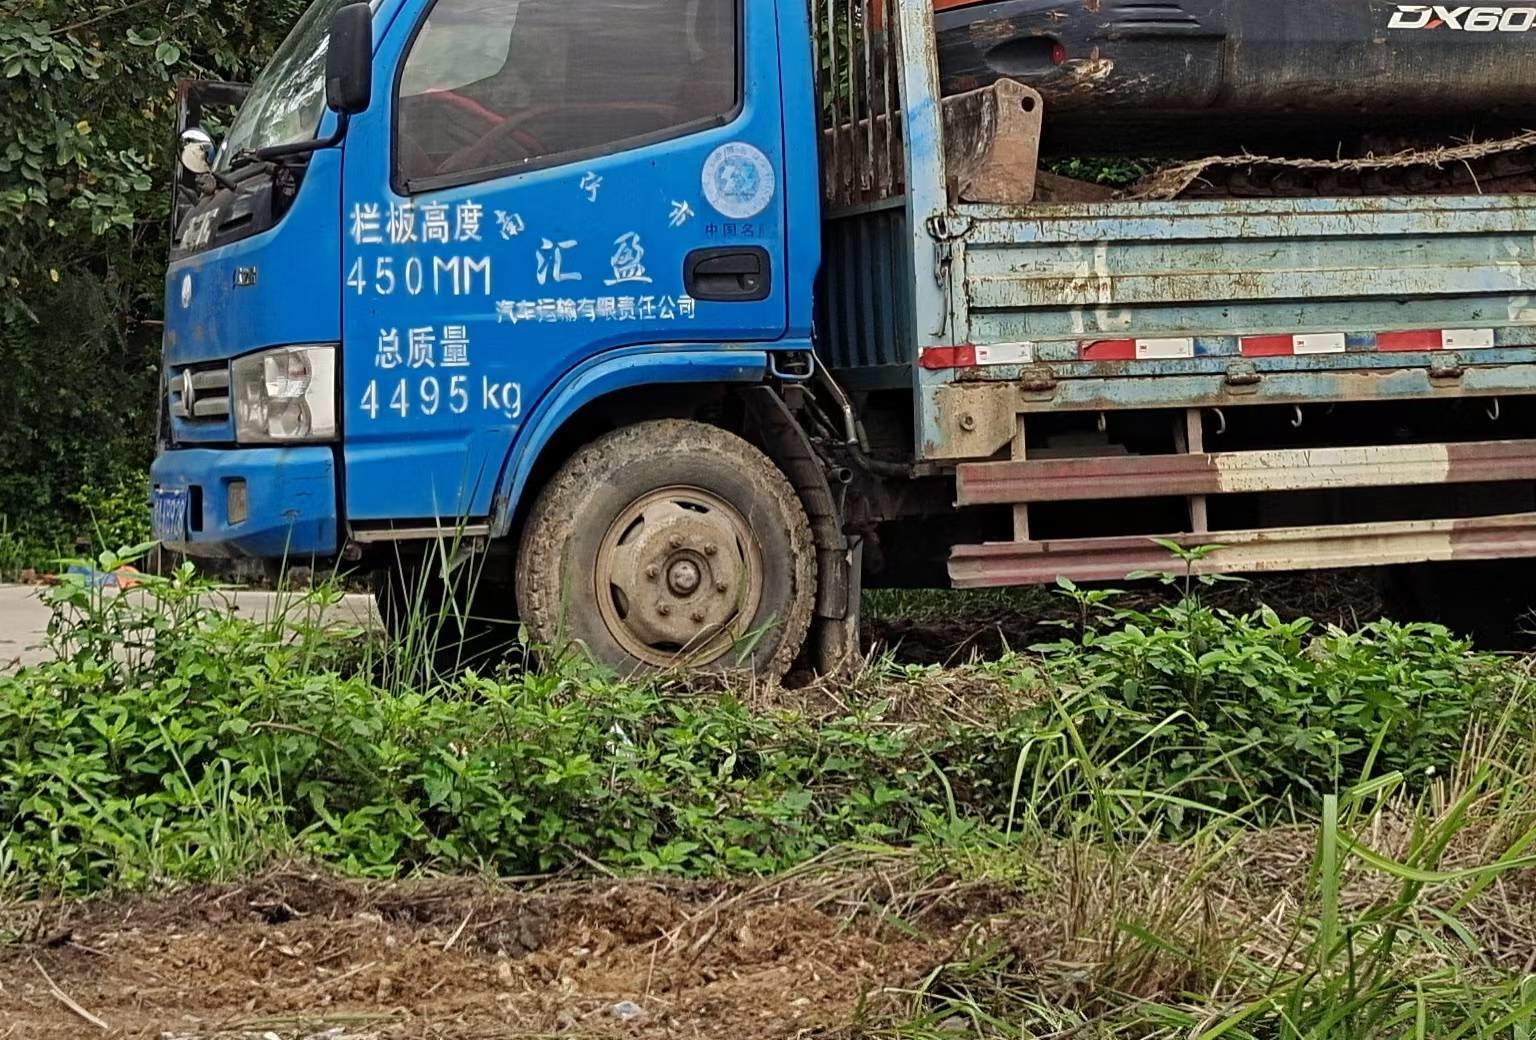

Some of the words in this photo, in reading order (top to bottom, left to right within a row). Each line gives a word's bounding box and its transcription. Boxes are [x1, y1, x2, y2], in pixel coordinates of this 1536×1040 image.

[350, 200, 483, 245] 栏板高度
[535, 231, 653, 286] 汇盈
[495, 294, 696, 324] 汽车运输有限责任公司
[375, 325, 470, 369] 总质量
